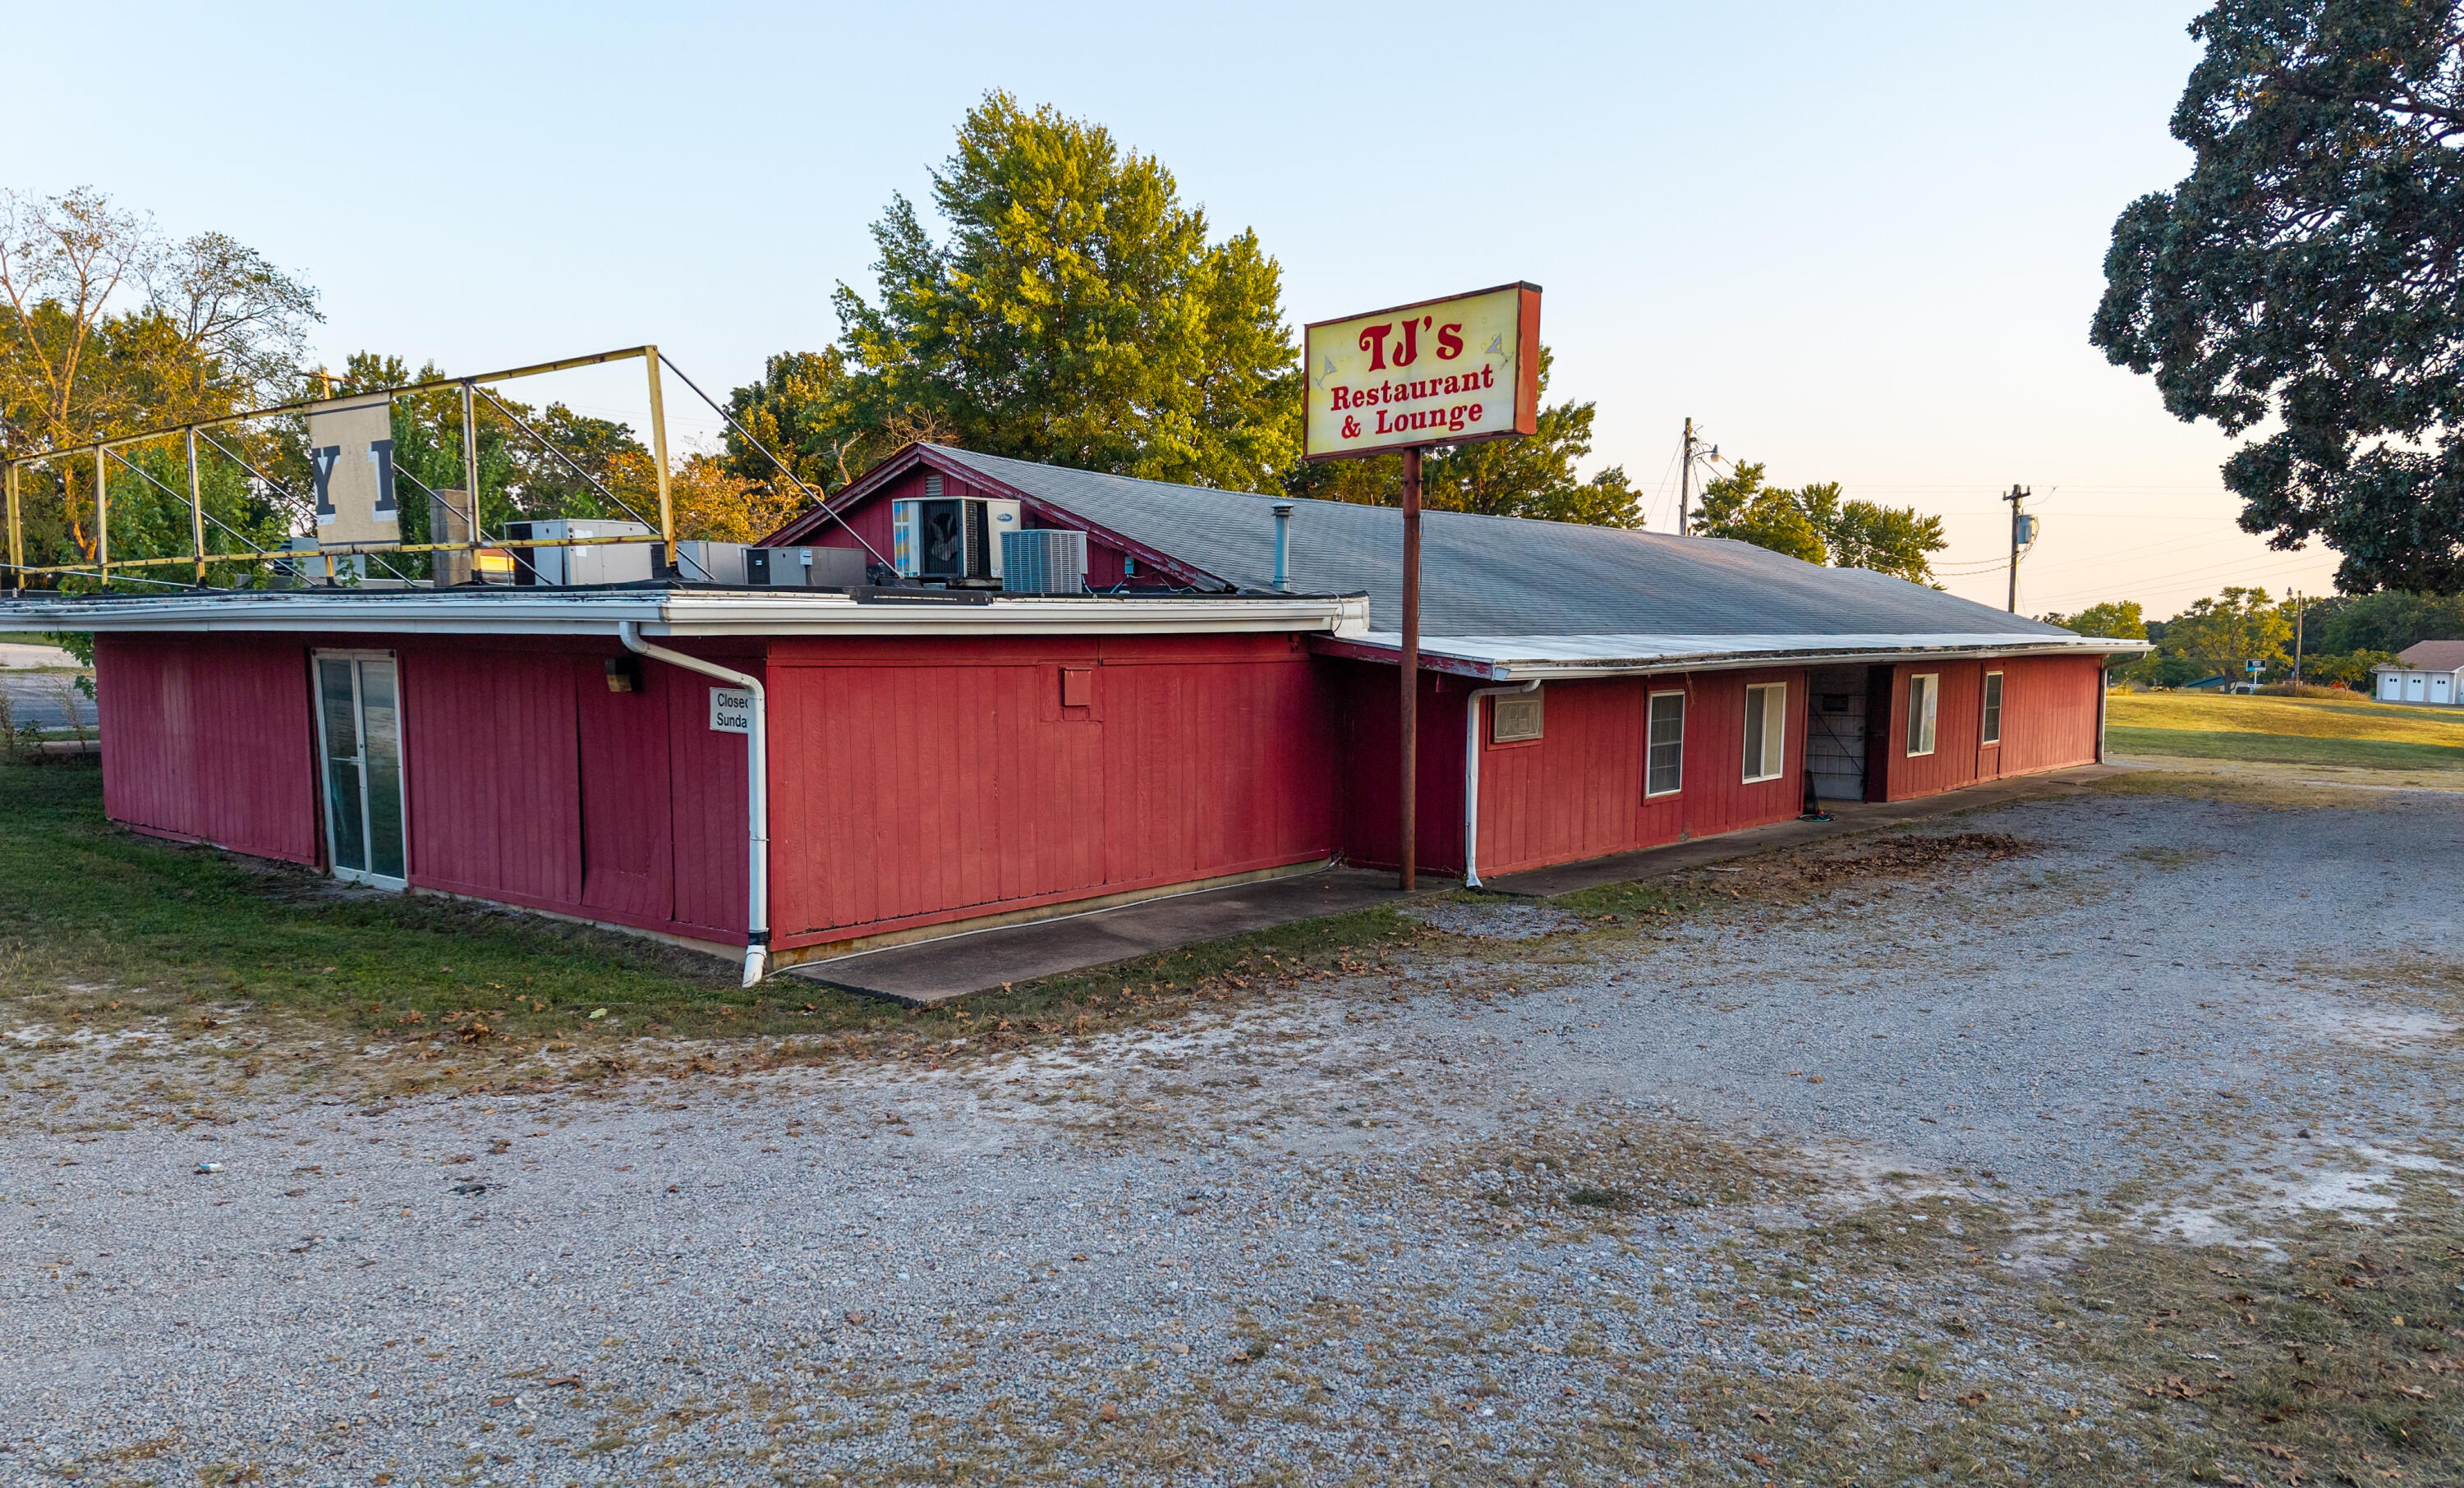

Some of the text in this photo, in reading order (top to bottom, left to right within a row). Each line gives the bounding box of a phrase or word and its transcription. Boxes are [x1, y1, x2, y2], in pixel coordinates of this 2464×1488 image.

[1358, 315, 1464, 372] TJ's
[1331, 364, 1494, 411] Restaurant
[1341, 403, 1483, 439] & Lounge
[716, 712, 748, 728] Sunda
